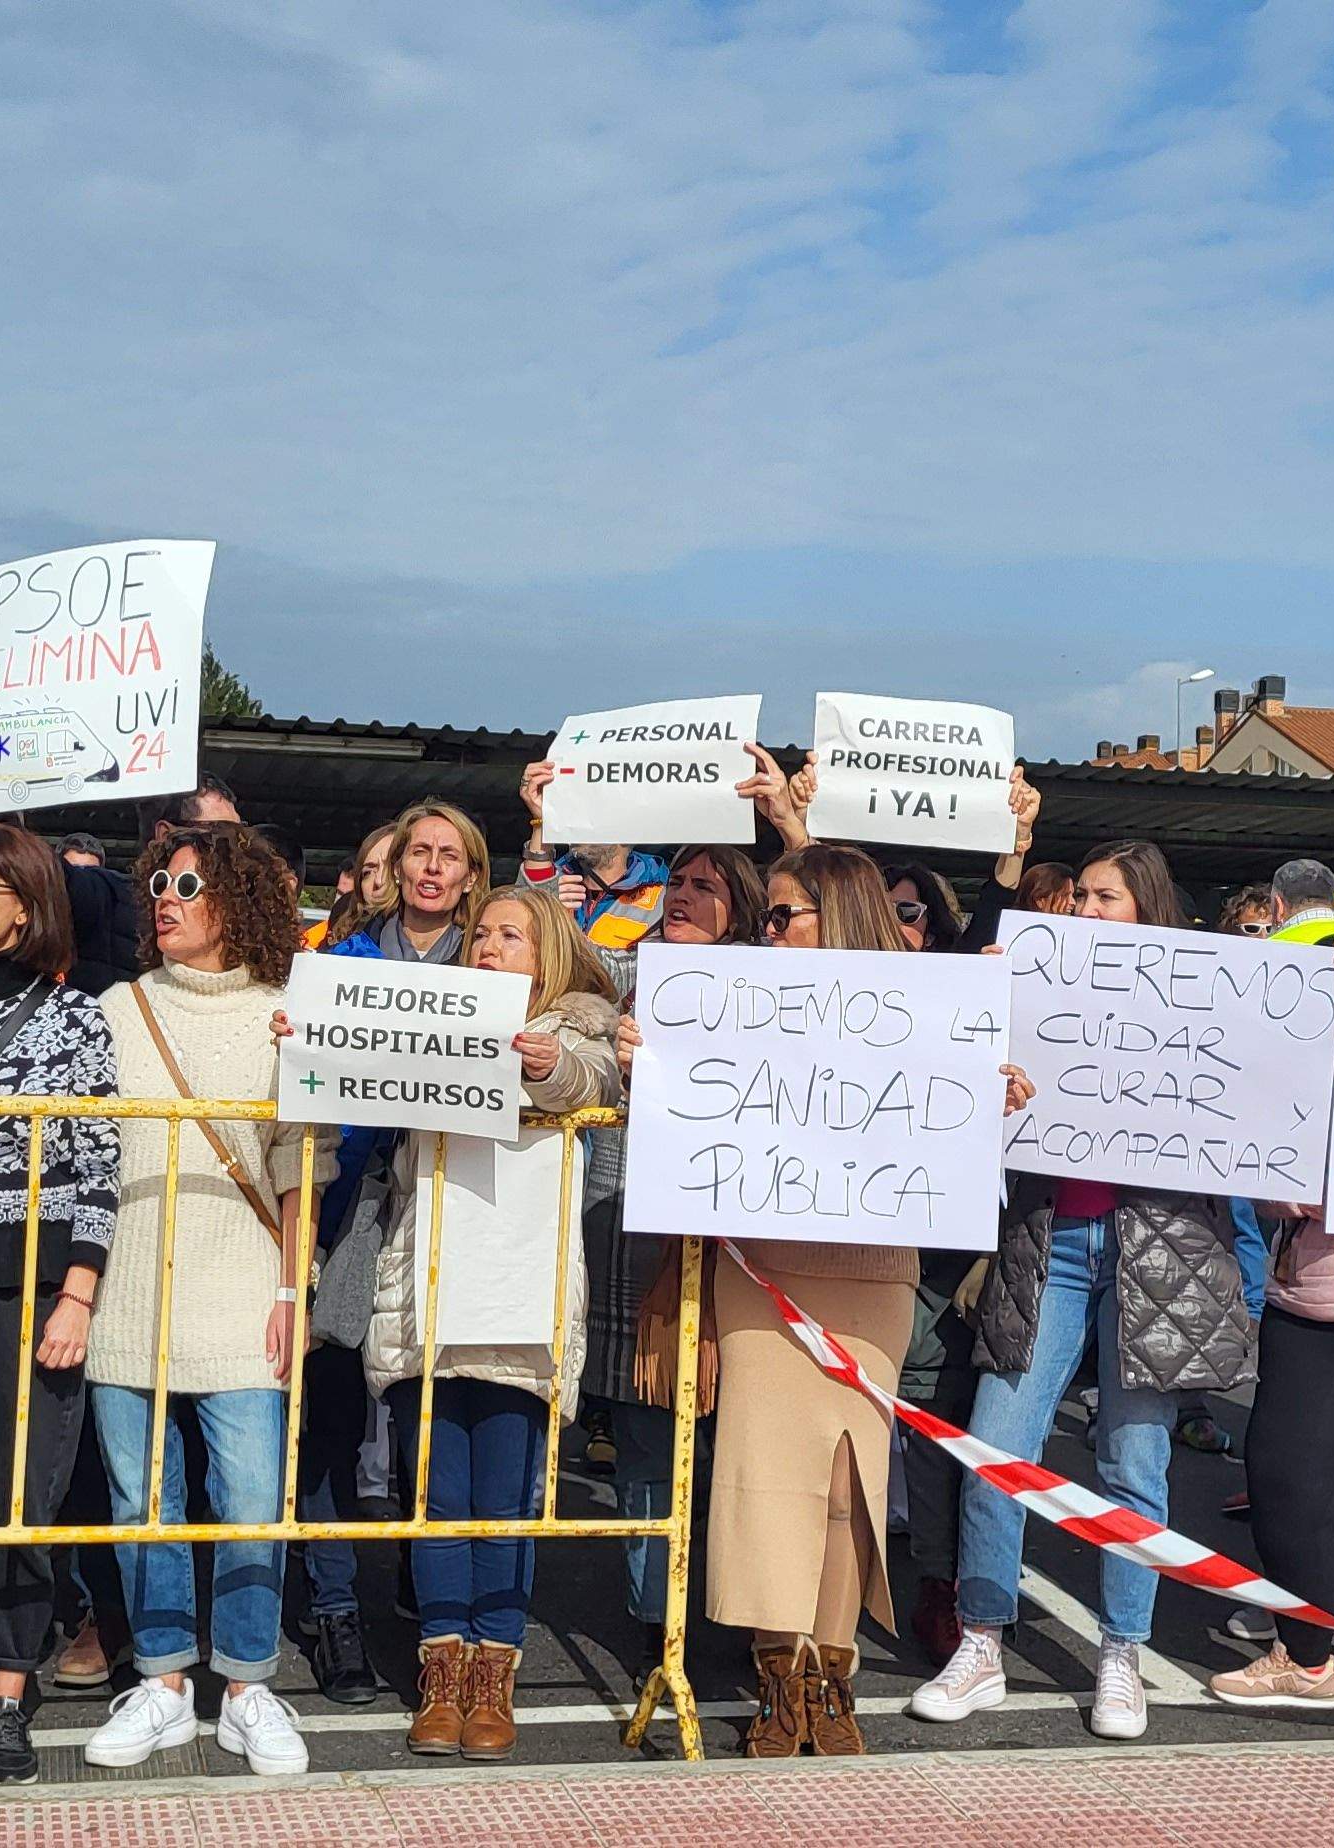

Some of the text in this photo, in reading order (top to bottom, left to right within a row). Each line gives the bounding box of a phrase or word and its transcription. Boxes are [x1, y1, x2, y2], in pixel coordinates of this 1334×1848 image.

[599, 721, 738, 743] PERSONAL
[858, 717, 983, 746] CARRERA
[126, 730, 170, 774] 24
[830, 749, 1006, 780] PROFESIONAL
[587, 762, 720, 783] DEMORAS
[334, 983, 478, 1017] MEJORES
[305, 1022, 500, 1059] HOSPITALES
[949, 1007, 1002, 1046] LA
[339, 1076, 504, 1111] RECURSOS
[1057, 1064, 1236, 1120] CURAR
[1004, 1113, 1307, 1188] ACOMPAÑAR
